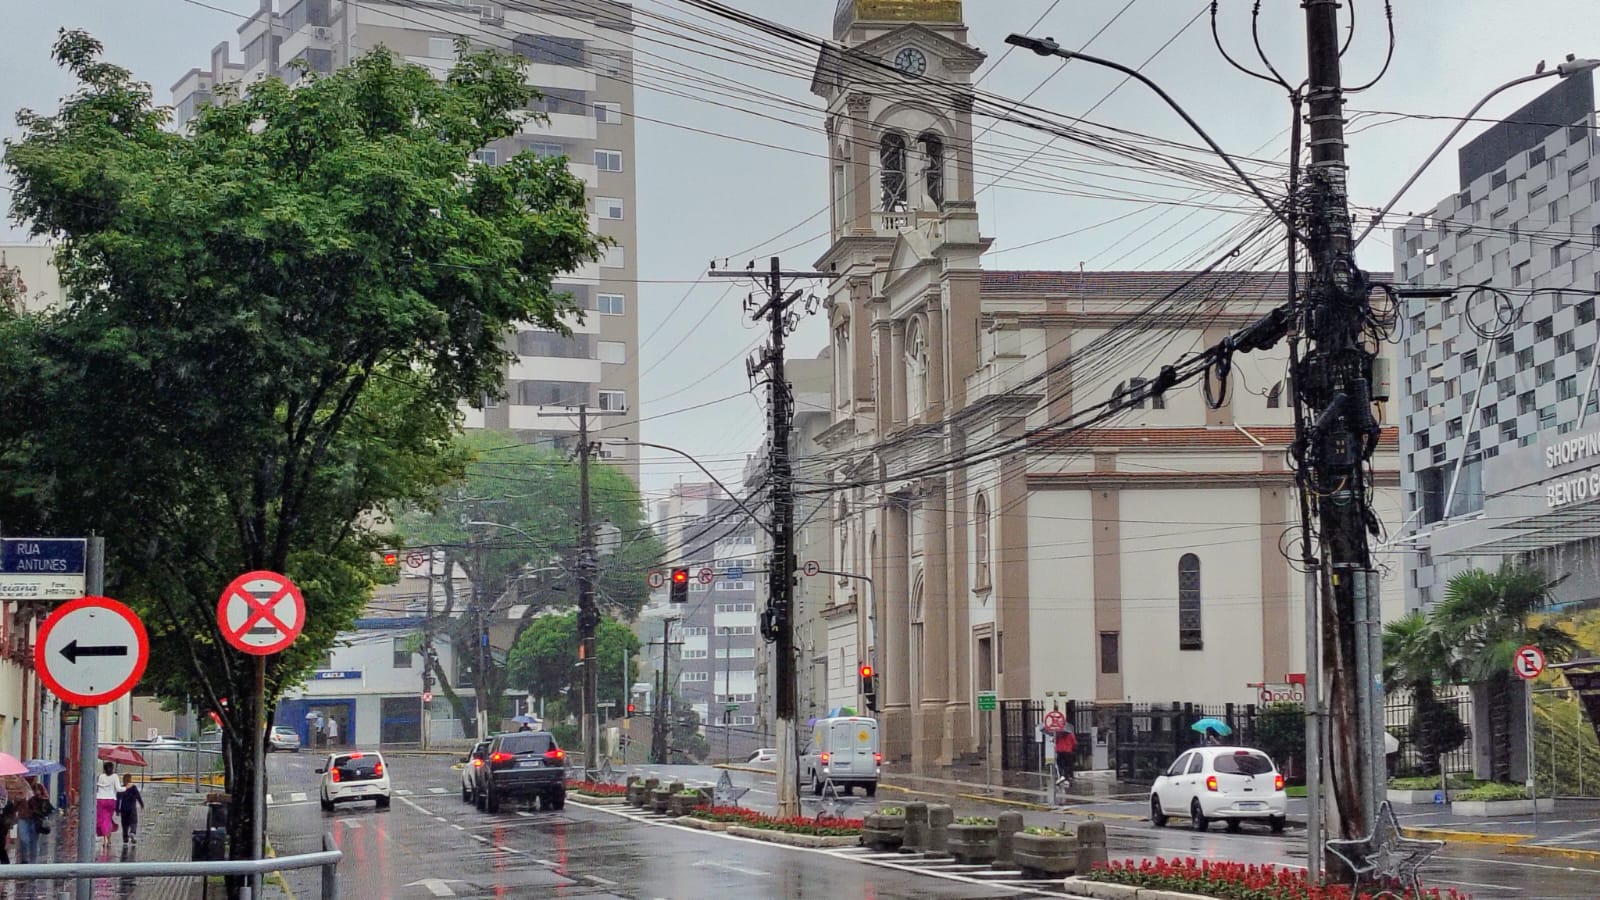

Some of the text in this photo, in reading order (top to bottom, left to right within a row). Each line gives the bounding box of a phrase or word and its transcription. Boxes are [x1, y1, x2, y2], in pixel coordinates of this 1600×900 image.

[1546, 431, 1600, 468] SHOPPIN
[1547, 477, 1587, 507] BENTO
[17, 543, 40, 555] RUA
[17, 558, 67, 571] ANTUNES
